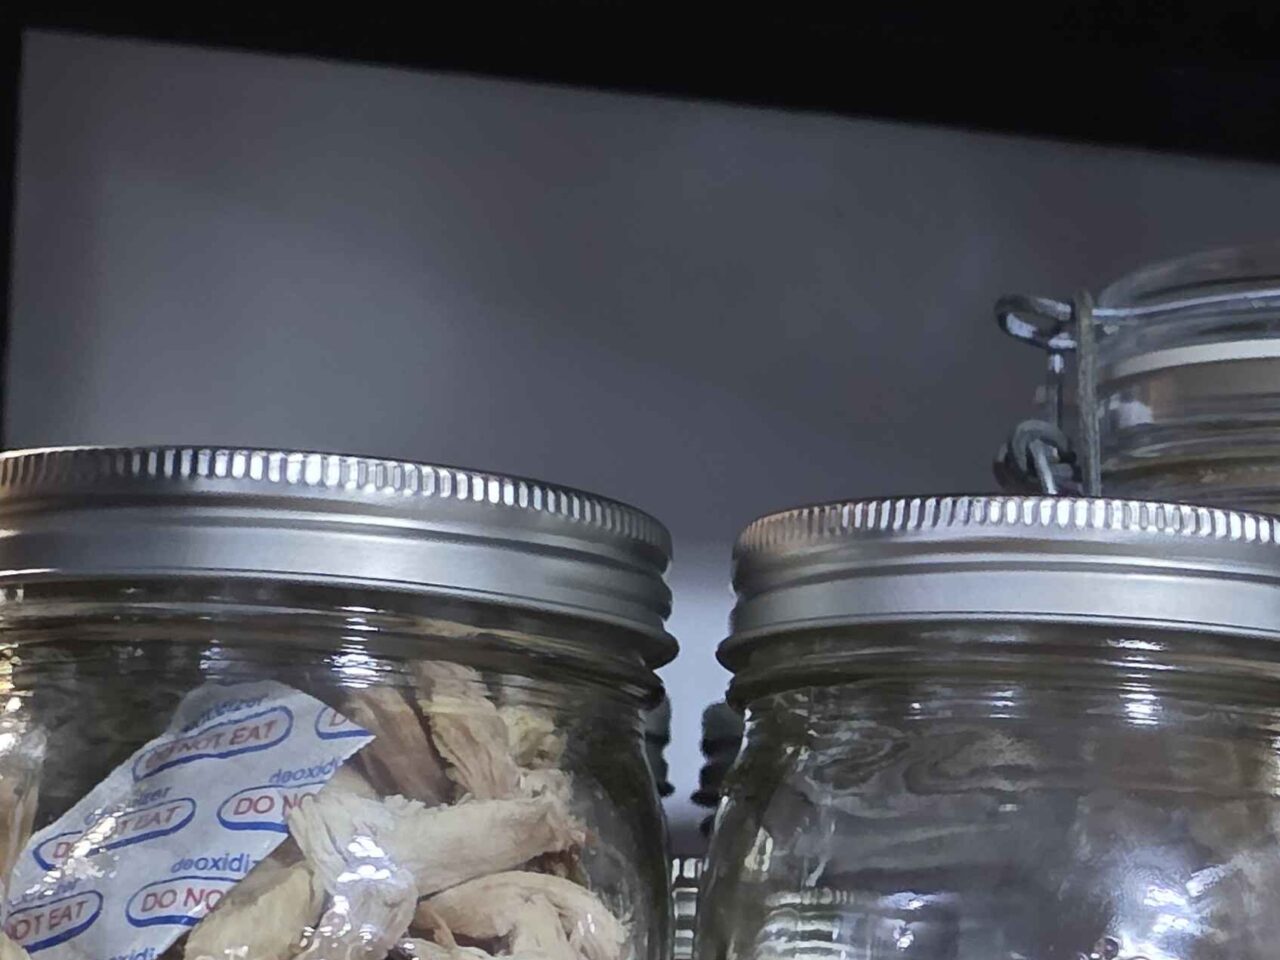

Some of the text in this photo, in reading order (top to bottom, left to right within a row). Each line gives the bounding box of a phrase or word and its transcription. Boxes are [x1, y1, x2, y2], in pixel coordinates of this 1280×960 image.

[229, 719, 278, 746] EAT
[233, 796, 274, 815] DO
[141, 889, 177, 913] DO
[48, 900, 89, 931] EAT
